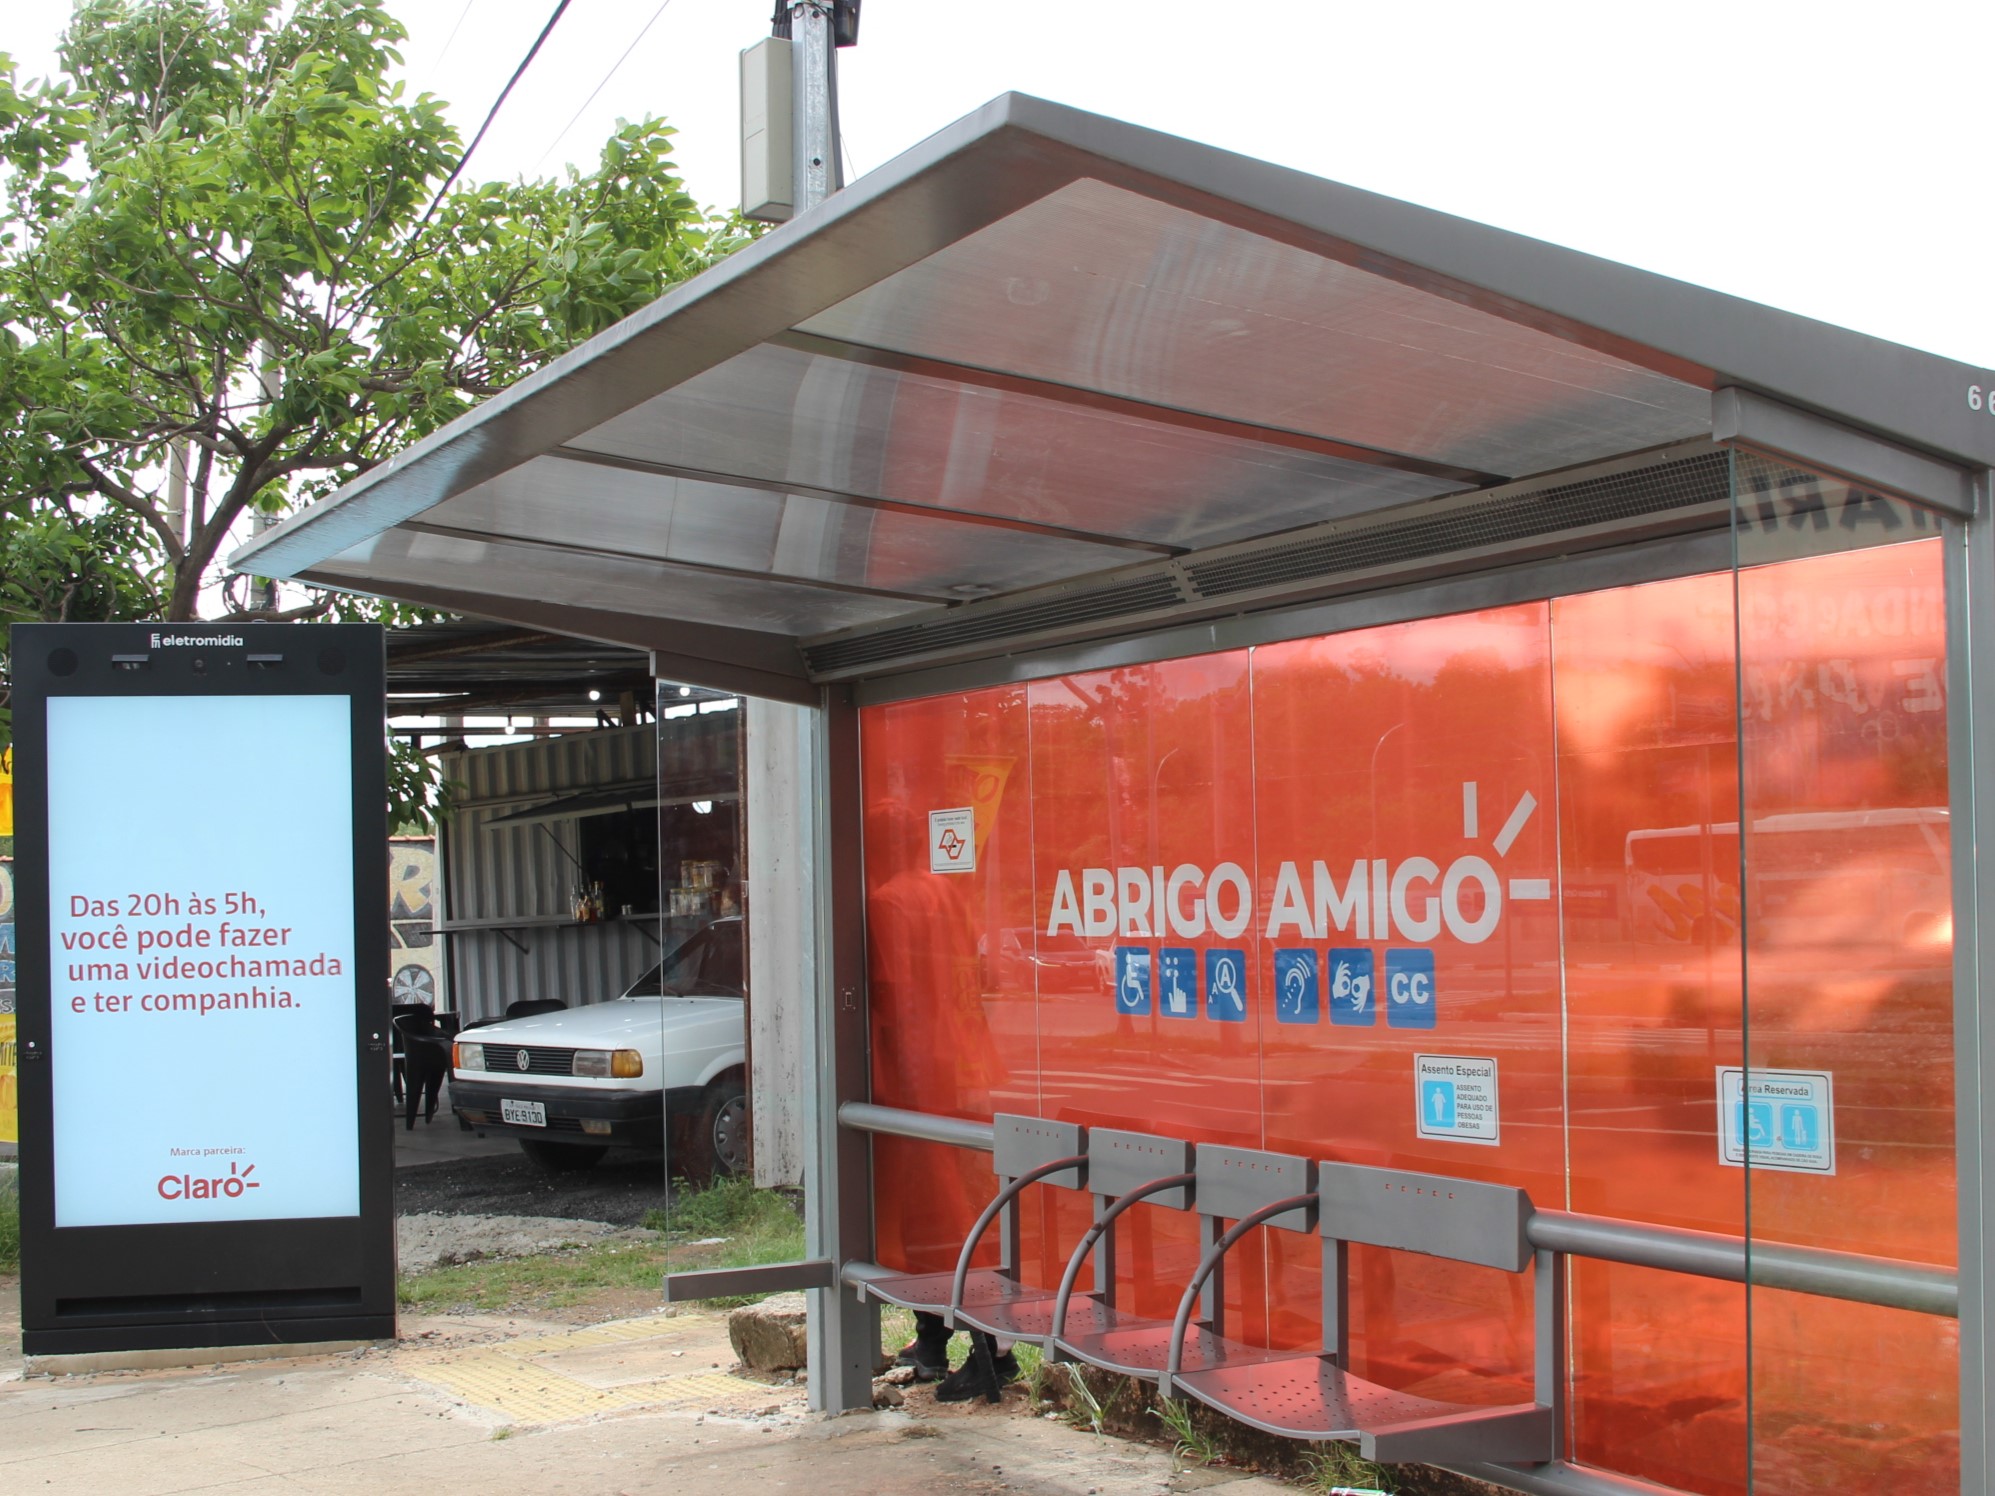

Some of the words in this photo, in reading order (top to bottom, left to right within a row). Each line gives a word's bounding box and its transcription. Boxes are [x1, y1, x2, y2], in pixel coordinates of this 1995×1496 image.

[162, 634, 244, 646] eletromidia
[70, 895, 120, 917] Das
[127, 893, 180, 916] 20h
[188, 892, 217, 916] às
[224, 891, 266, 918] 5h,
[1046, 862, 1253, 939] ABRIGO
[1265, 855, 1502, 945] AMIGO
[61, 924, 128, 950] você
[137, 923, 211, 955] pode
[219, 922, 292, 947] fazer
[68, 962, 129, 981] uma
[137, 952, 343, 980] videochamada
[1391, 972, 1430, 1004] CC
[71, 995, 86, 1013] e
[94, 991, 133, 1013] ter
[140, 986, 302, 1016] companhia.
[1421, 1064, 1454, 1075] Assento
[1456, 1066, 1491, 1078] Especial
[1456, 1084, 1482, 1092] ASSENTO
[1764, 1085, 1809, 1096] Reservada
[1456, 1094, 1488, 1102] ADEQUADO
[1457, 1112, 1483, 1120] PESSOAS
[1457, 1122, 1480, 1130] OBESAS
[170, 1147, 201, 1157] Marca
[203, 1146, 246, 1157] parceira:
[157, 1174, 244, 1200] Claro
